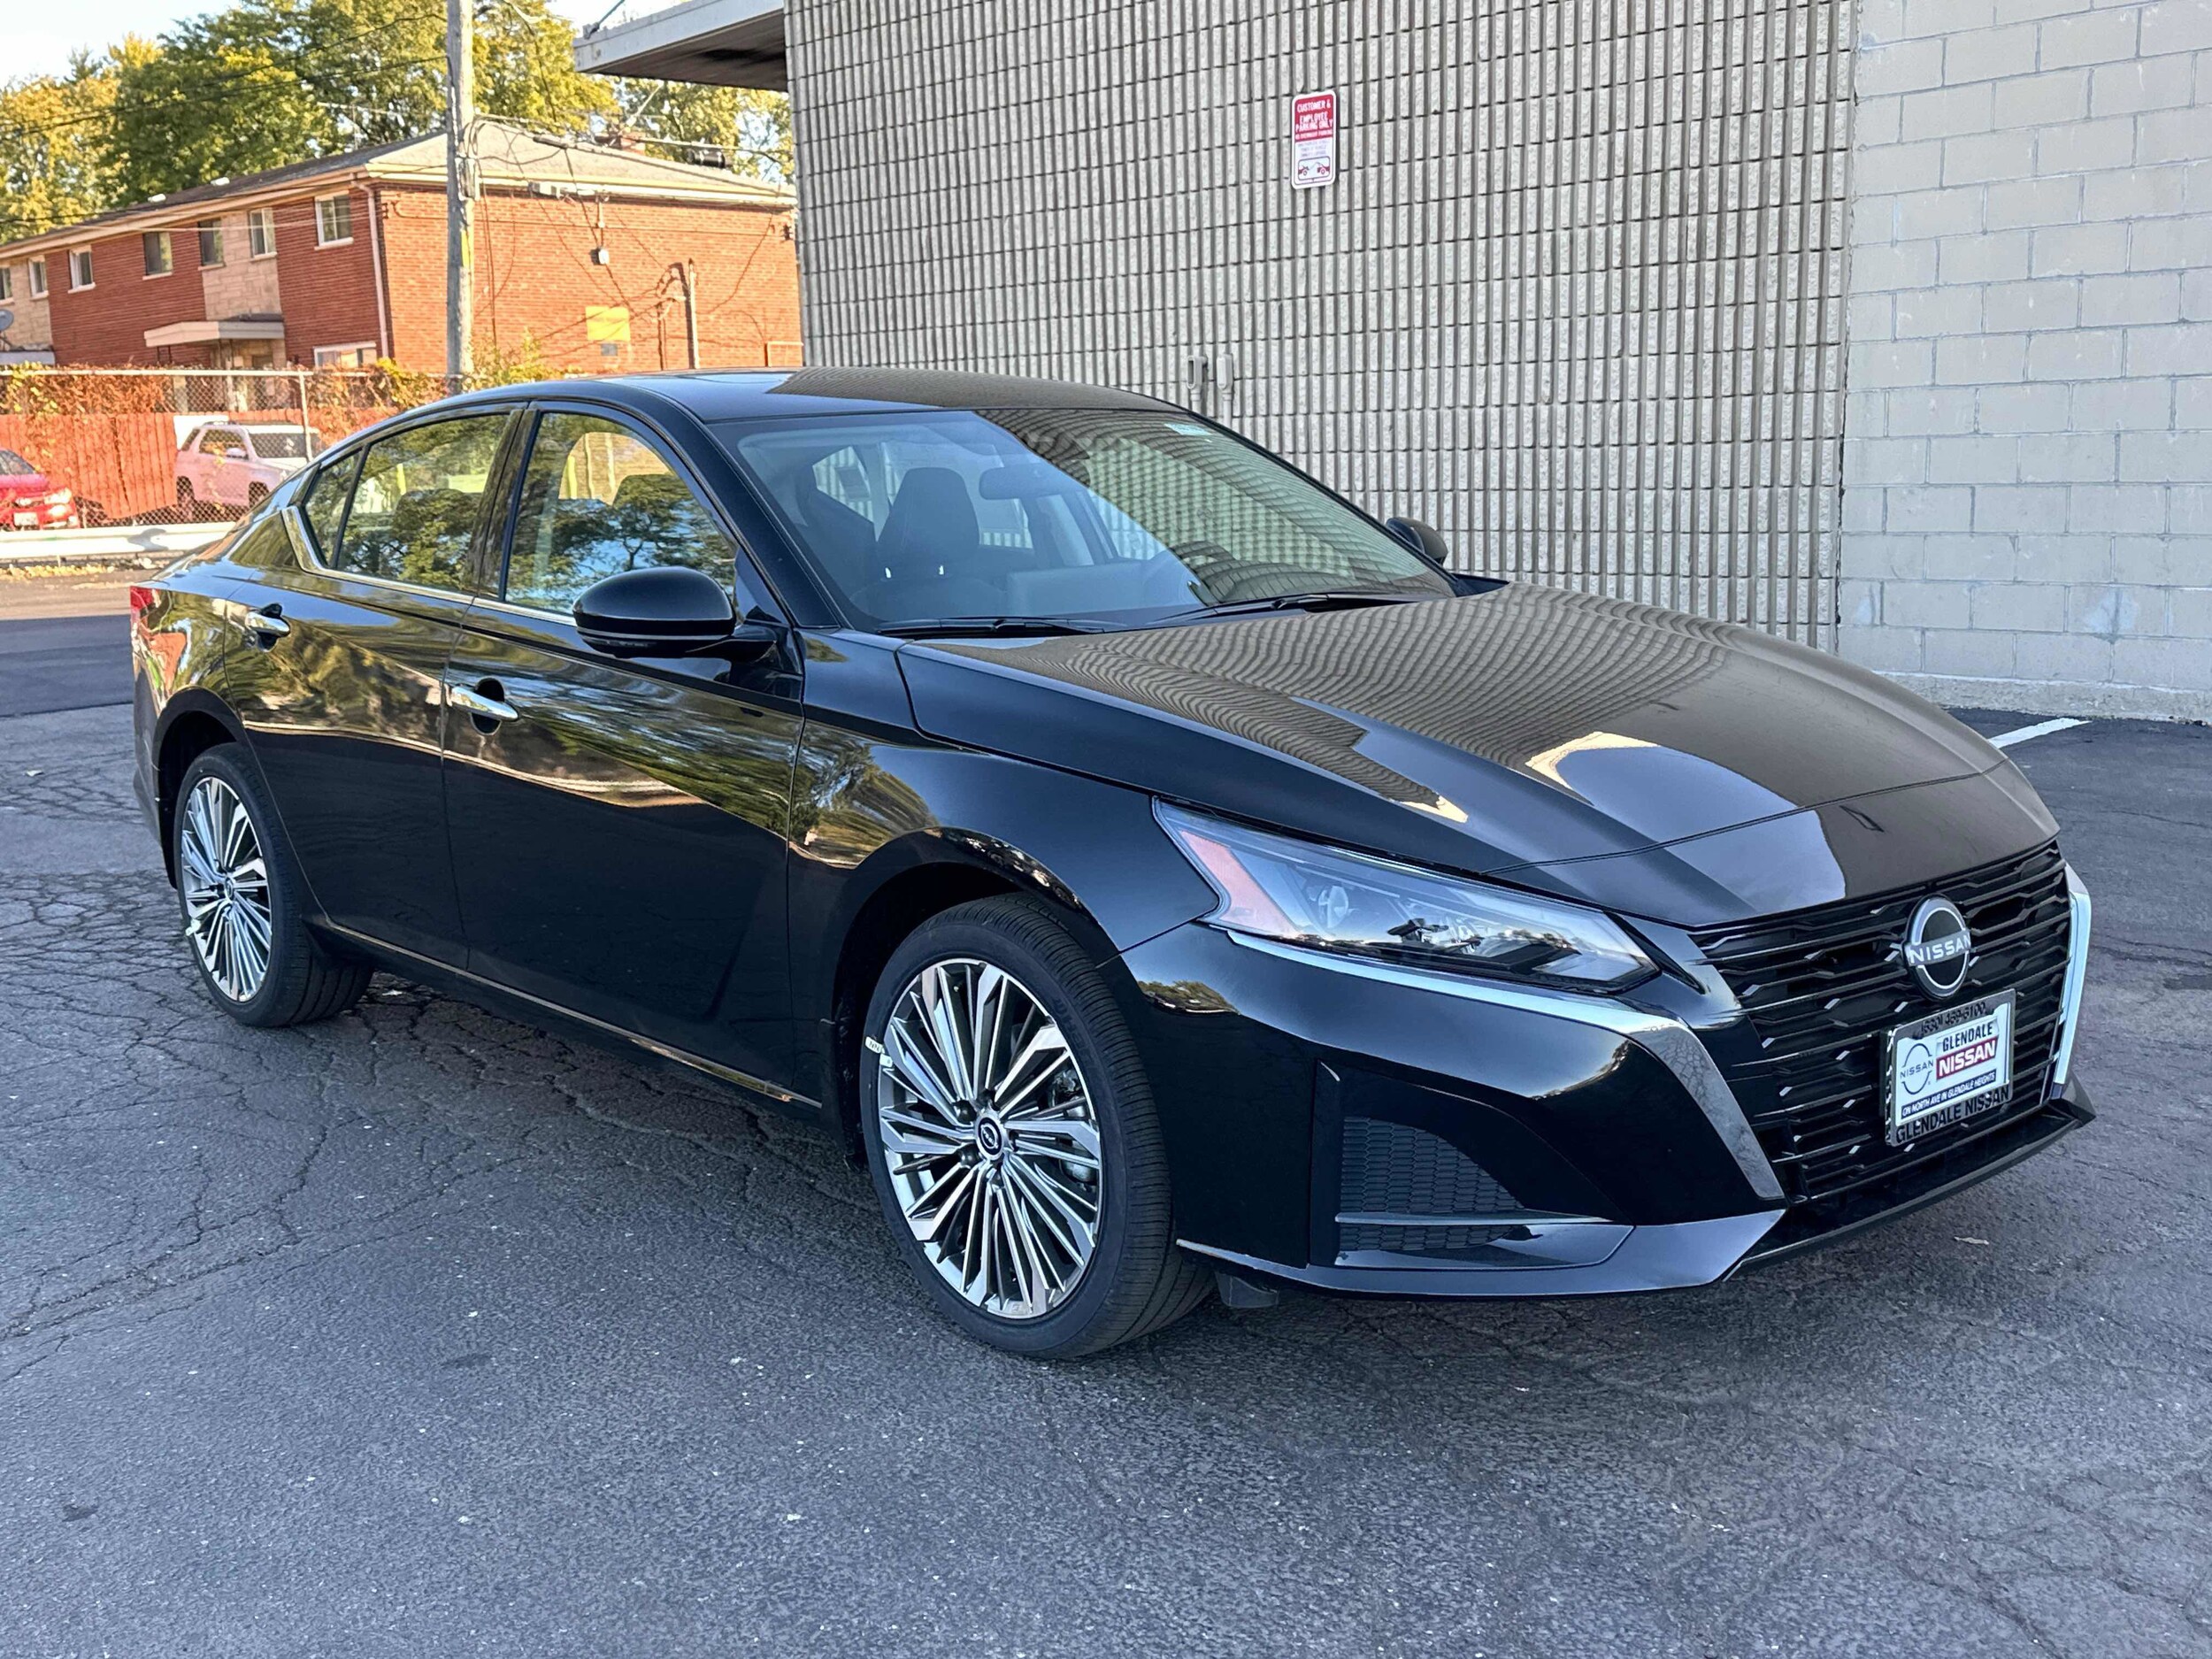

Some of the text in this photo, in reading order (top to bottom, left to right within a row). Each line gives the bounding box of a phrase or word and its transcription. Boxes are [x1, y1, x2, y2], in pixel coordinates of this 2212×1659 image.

[1297, 100, 1326, 113] CUSTOMER
[1299, 111, 1328, 124] EMPLOYEE
[1909, 932, 1972, 966] NISSAN
[1942, 1022, 1993, 1053] GLENDALE
[1900, 1059, 1934, 1079] NISSAN
[1938, 1040, 1997, 1078] NISSAN
[1901, 1071, 1996, 1117] ON NORTH AVE IN GLENDALE HEIGHTS
[1895, 1087, 2009, 1144] GLENDALE NISSAN
